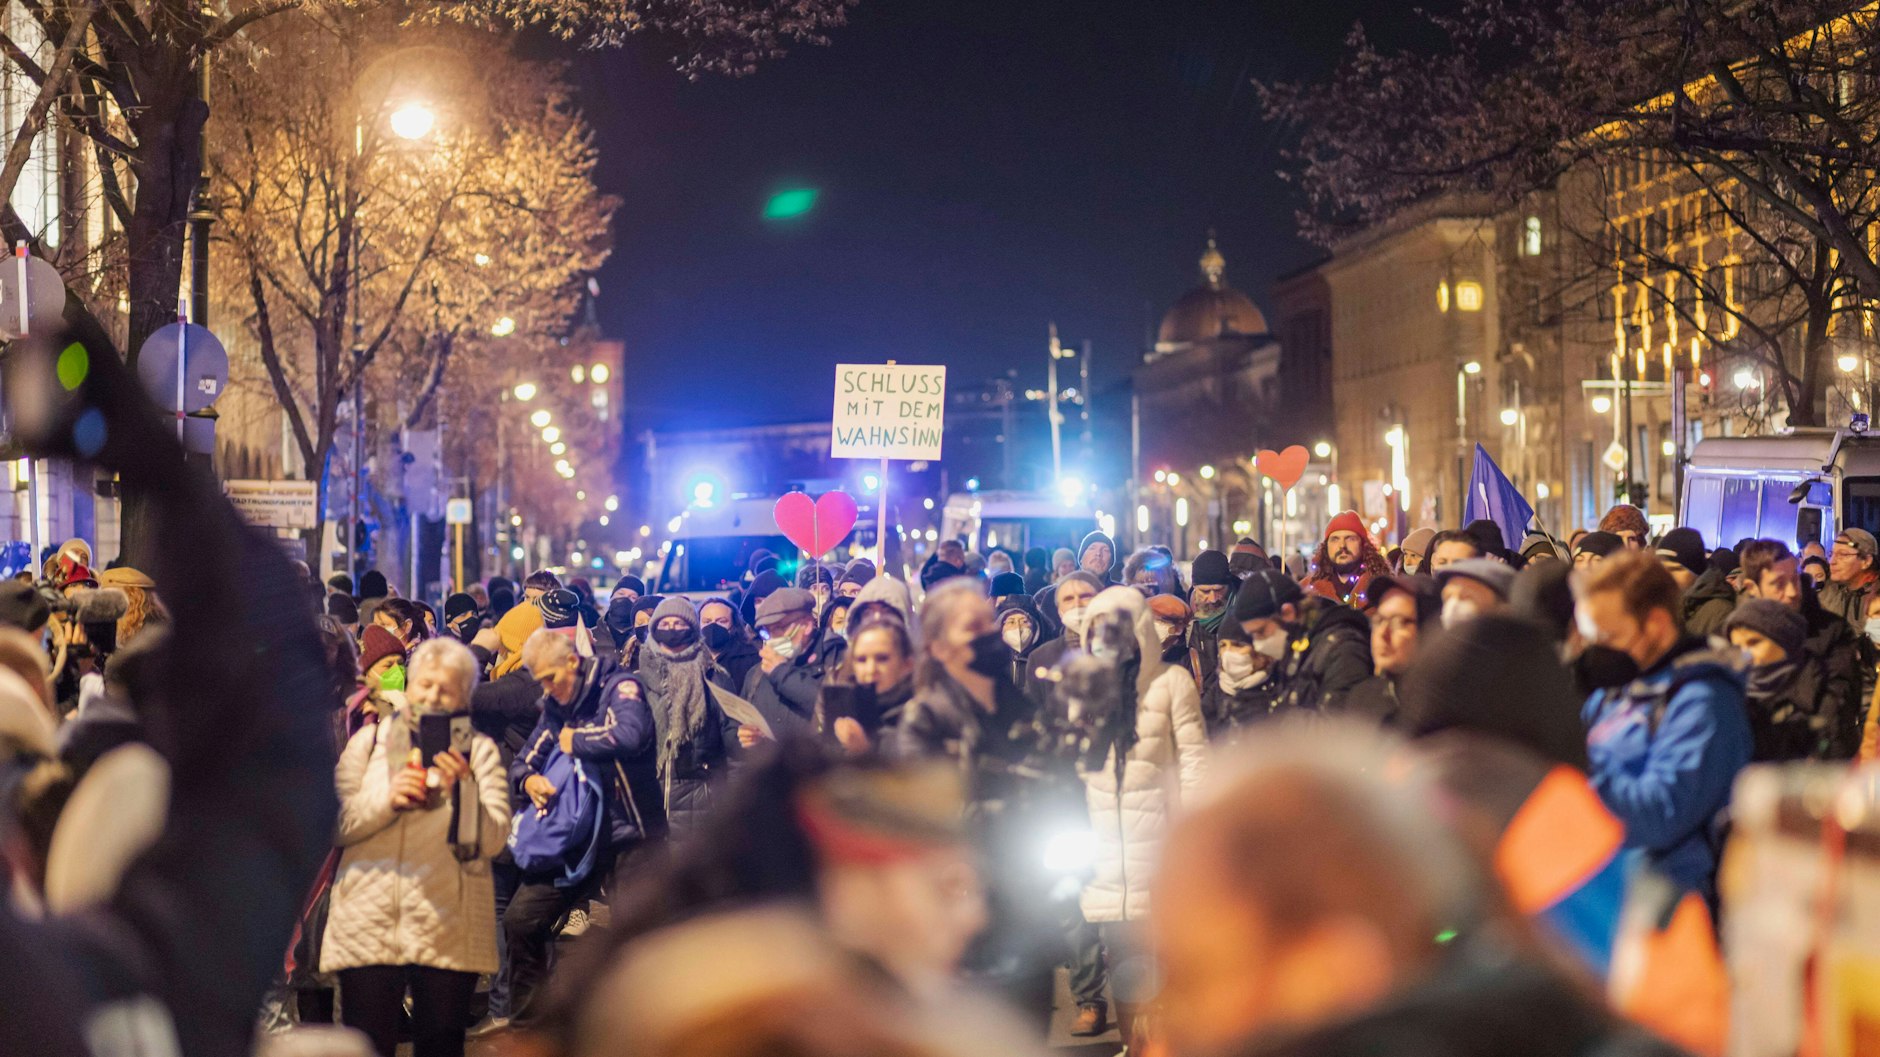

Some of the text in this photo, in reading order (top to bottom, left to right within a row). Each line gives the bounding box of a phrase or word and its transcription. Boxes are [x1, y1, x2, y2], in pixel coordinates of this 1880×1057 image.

[844, 371, 942, 395] SCHLUSS
[899, 401, 940, 419] DEM
[230, 498, 312, 506] TADTRUNDFAHRTEN
